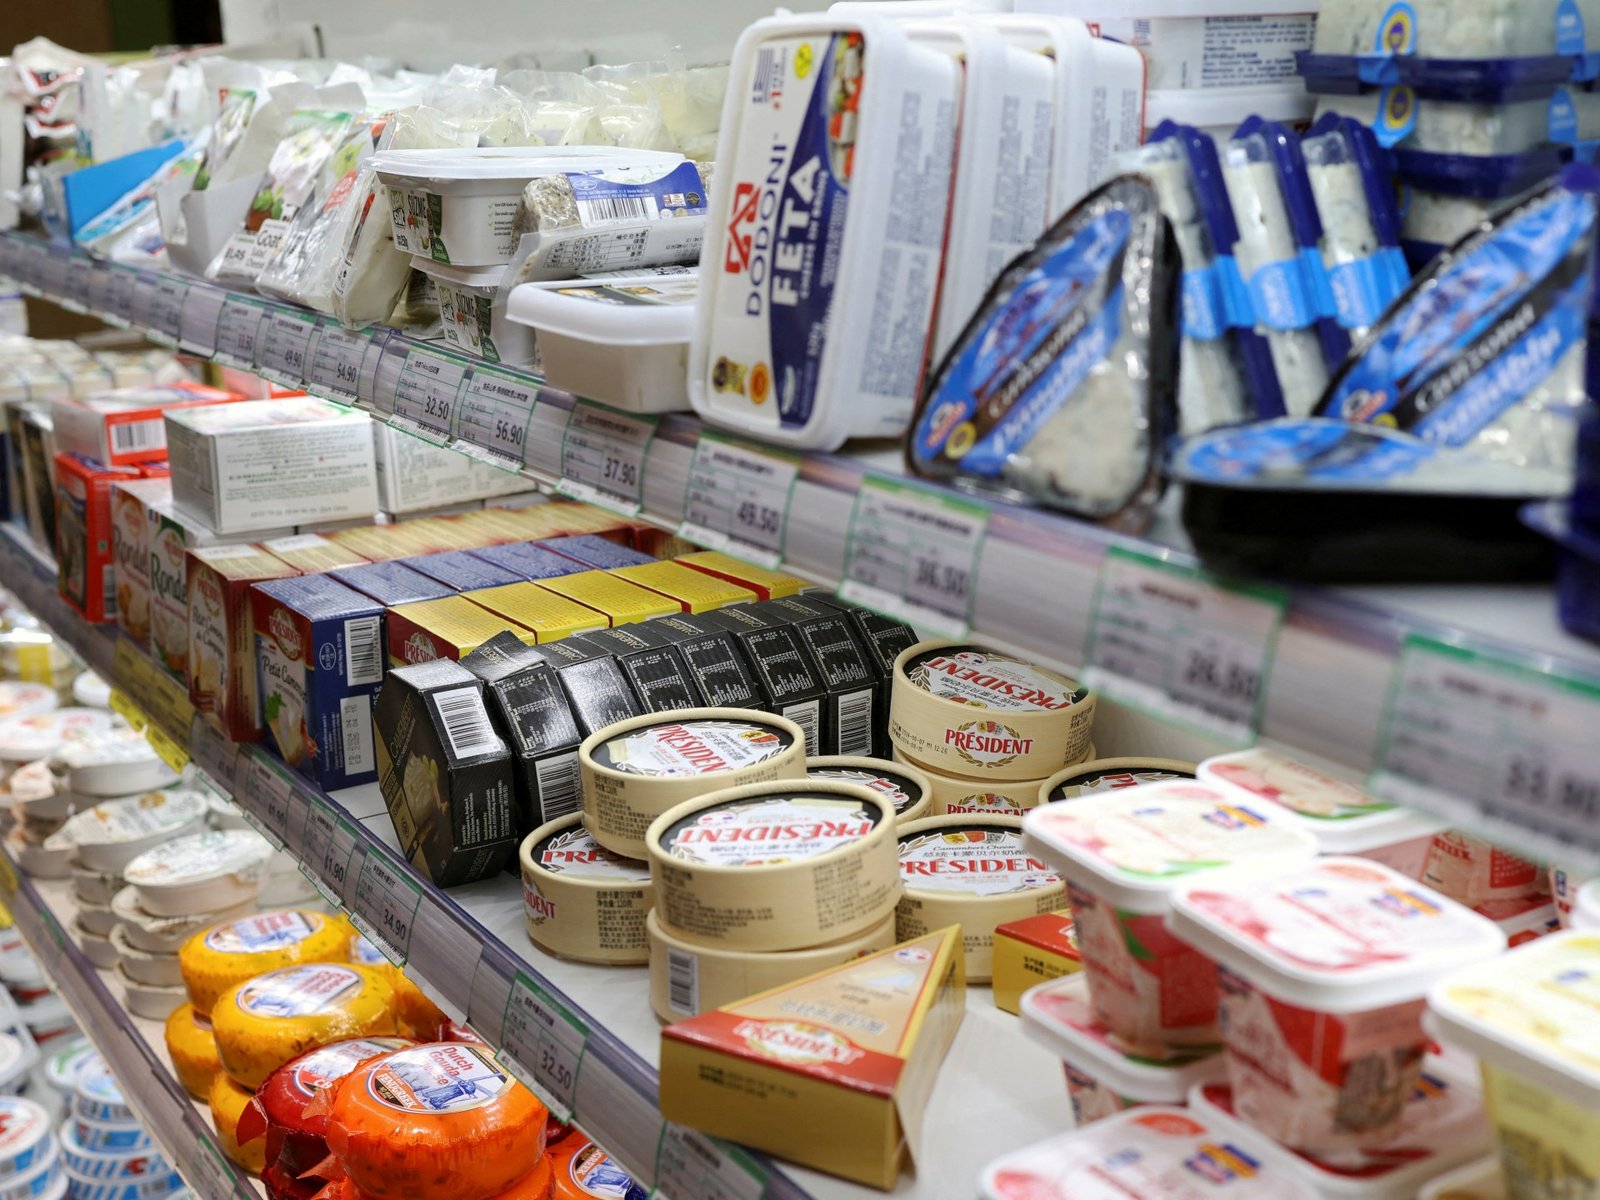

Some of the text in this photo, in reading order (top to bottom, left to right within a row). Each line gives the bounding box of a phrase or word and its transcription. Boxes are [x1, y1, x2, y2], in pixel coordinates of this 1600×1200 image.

[746, 144, 787, 317] DODONI
[771, 155, 821, 307] FETA
[337, 362, 357, 383] 54.90
[424, 396, 450, 420] 32.50
[495, 420, 523, 446] 56.90
[604, 455, 637, 487] 37.90
[262, 655, 282, 679] Petit
[925, 657, 1072, 711] PRÉSIDENT
[945, 728, 1034, 755] PRÉSIDENT
[676, 820, 873, 844] PRÉSIDENT
[383, 907, 407, 941] 34.90
[735, 1020, 865, 1064] PRÉSIDENT
[429, 1050, 460, 1078] Gouda
[443, 1047, 474, 1072] Dutch
[540, 1053, 572, 1091] 32.50
